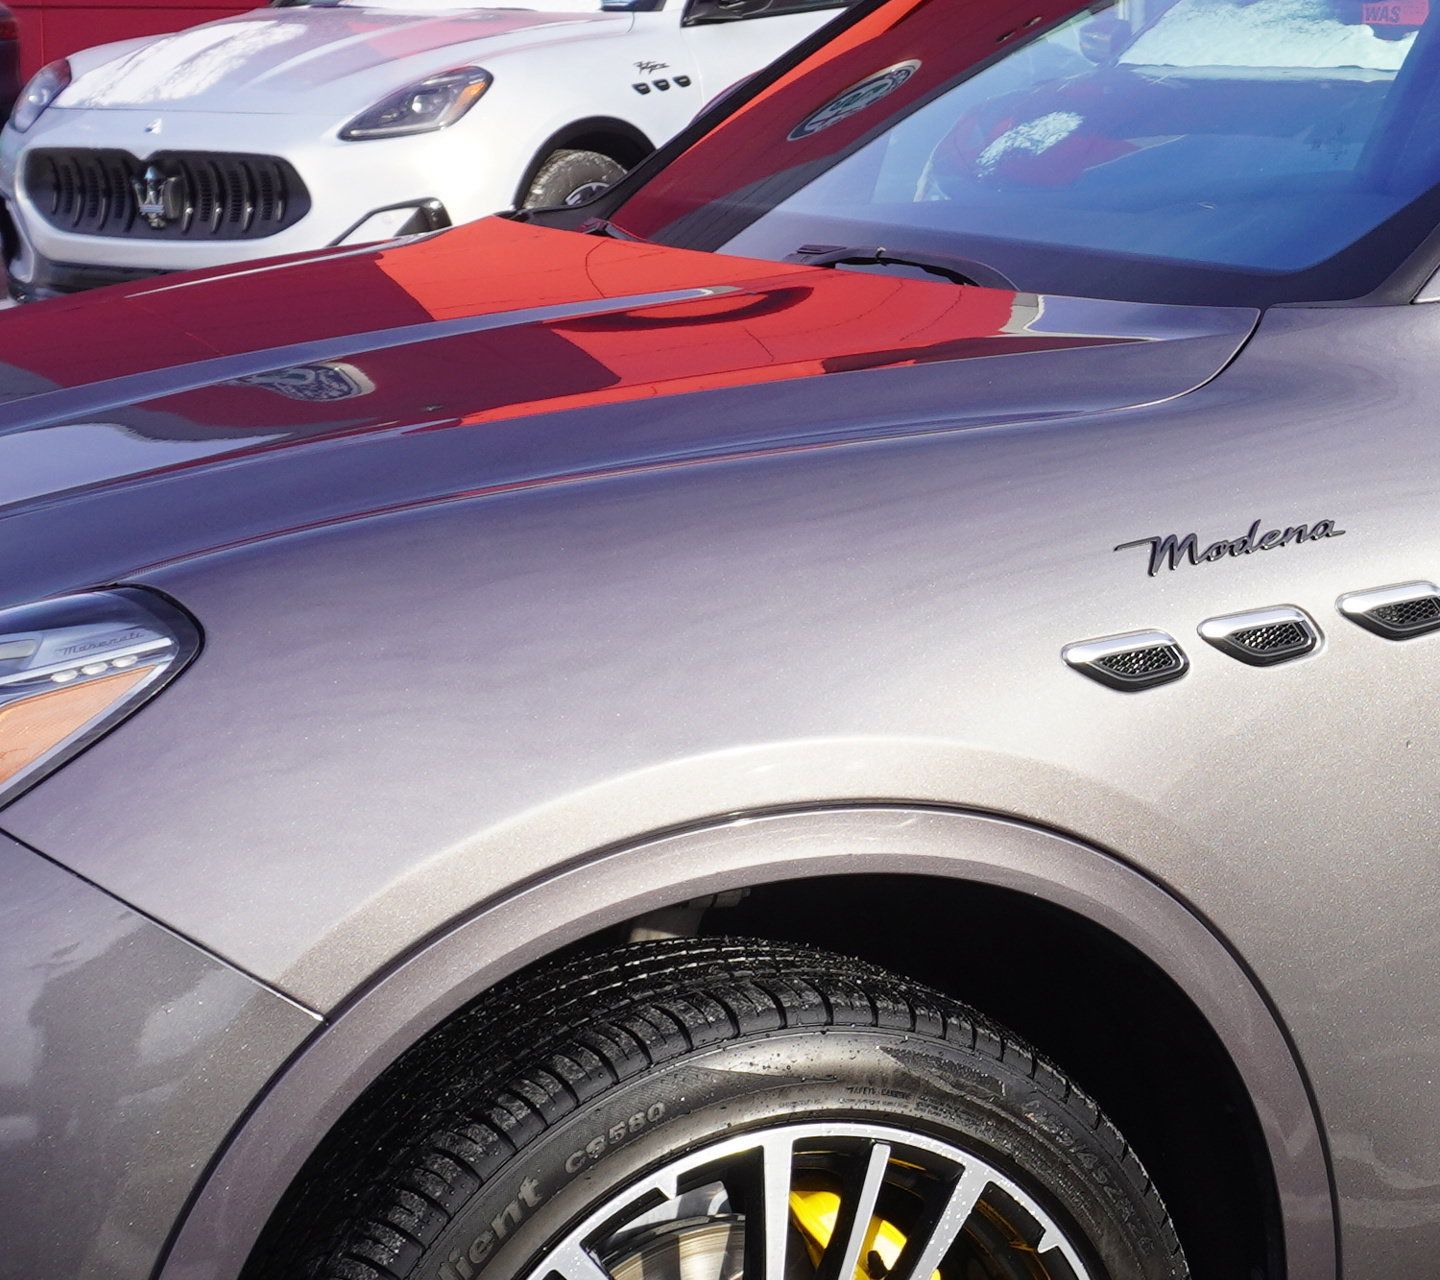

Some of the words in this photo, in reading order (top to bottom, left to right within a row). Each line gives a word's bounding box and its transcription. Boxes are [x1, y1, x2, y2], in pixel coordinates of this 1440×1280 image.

[1113, 519, 1347, 577] Modena
[55, 631, 145, 656] Maserati
[564, 1101, 666, 1174] CS580
